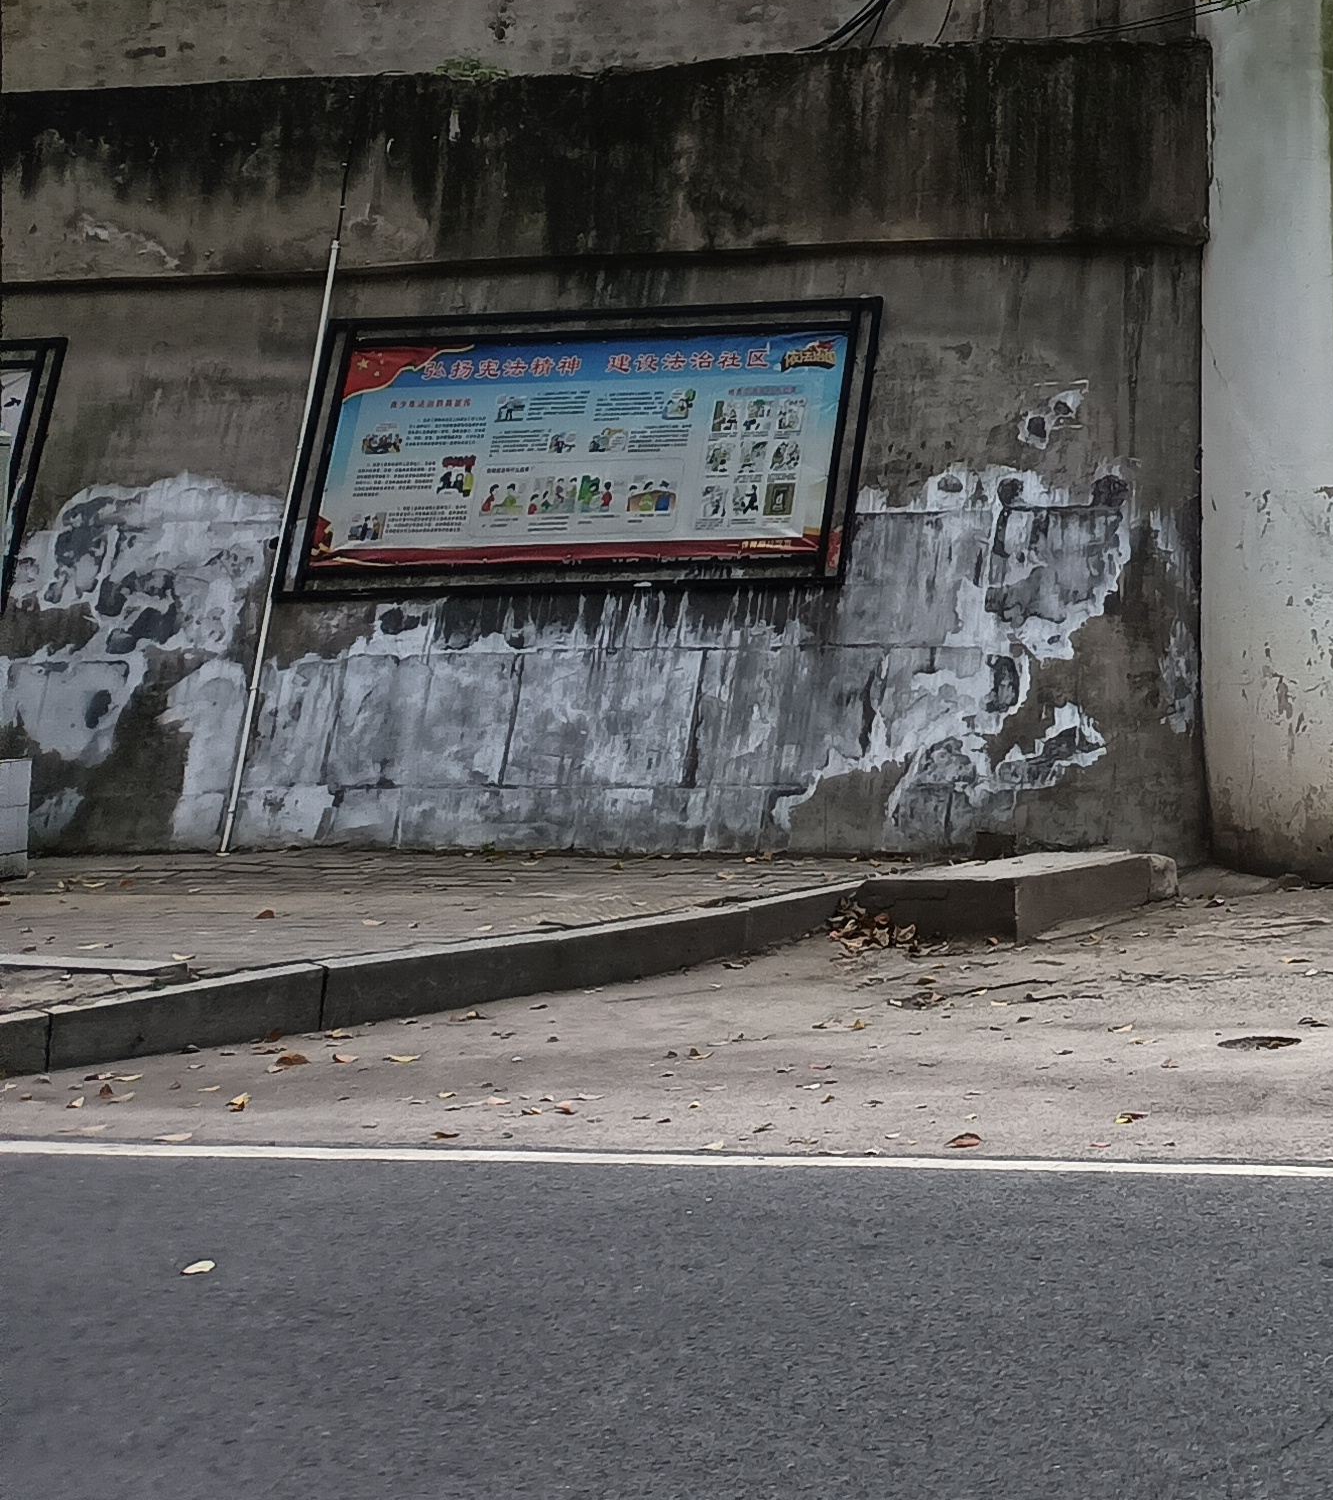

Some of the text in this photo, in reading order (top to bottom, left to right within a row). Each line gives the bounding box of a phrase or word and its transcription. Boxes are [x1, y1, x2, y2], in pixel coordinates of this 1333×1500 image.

[421, 348, 771, 381] 弘扬宪法精神 建设法治社区
